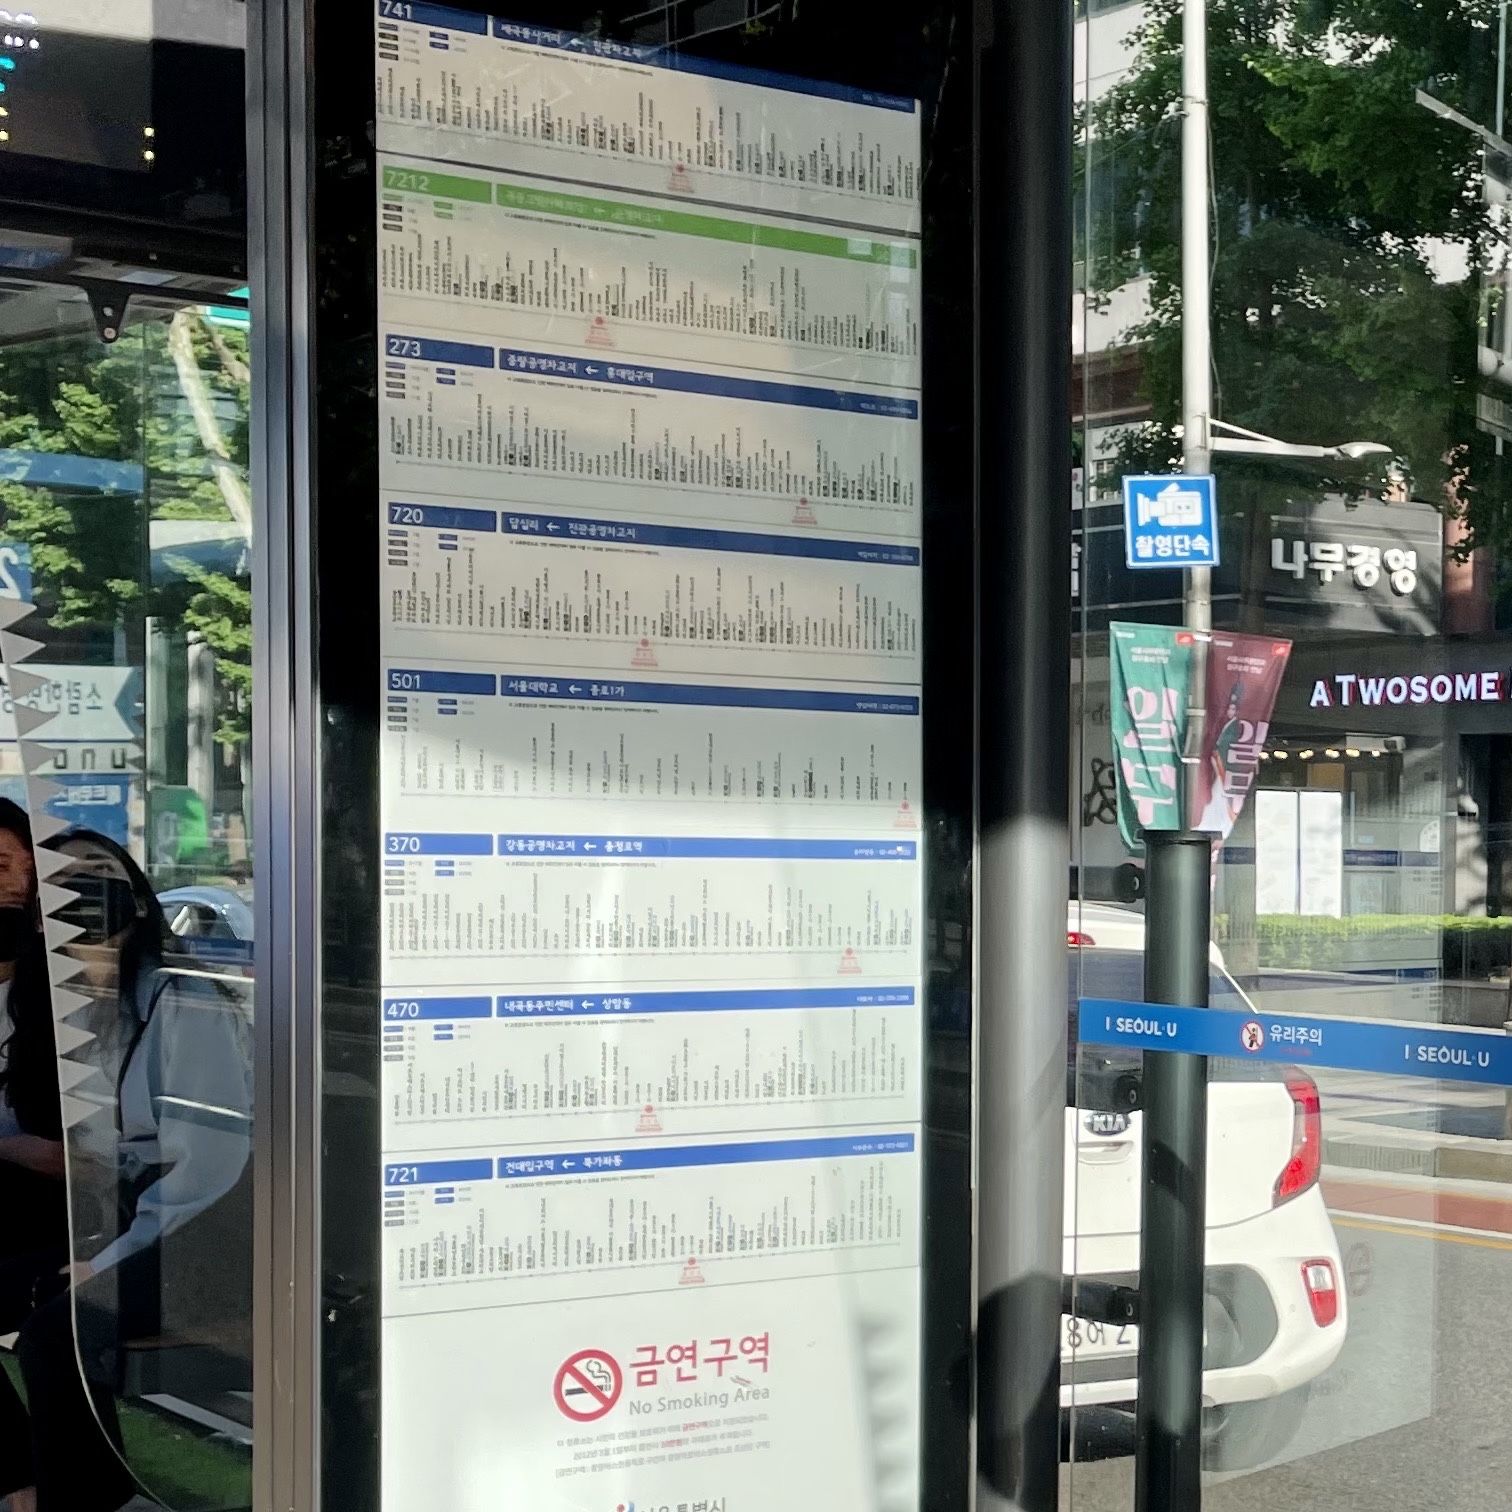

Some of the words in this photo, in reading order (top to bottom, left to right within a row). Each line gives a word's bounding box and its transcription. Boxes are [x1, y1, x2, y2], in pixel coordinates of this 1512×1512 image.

[382, 1, 413, 19] 741
[385, 170, 430, 192] 7212
[389, 338, 421, 357] 273
[391, 507, 423, 524] 720
[1135, 533, 1210, 559] 촬영단속
[1271, 537, 1418, 597] 나무경영
[391, 673, 421, 690] 501
[508, 680, 558, 694] 서울대학교
[1310, 680, 1331, 708] A
[1335, 671, 1500, 708] TWOSOME
[389, 837, 420, 852] 370
[387, 1002, 419, 1017] 470
[602, 998, 632, 1010] 상암동
[1270, 1024, 1322, 1047] 유리주의
[1093, 1113, 1127, 1133] KIA
[389, 1167, 418, 1183] 721
[629, 1332, 769, 1387] 금연구역
[629, 1401, 652, 1415] No
[657, 1391, 729, 1412] Smoking
[734, 1388, 770, 1403] Area
